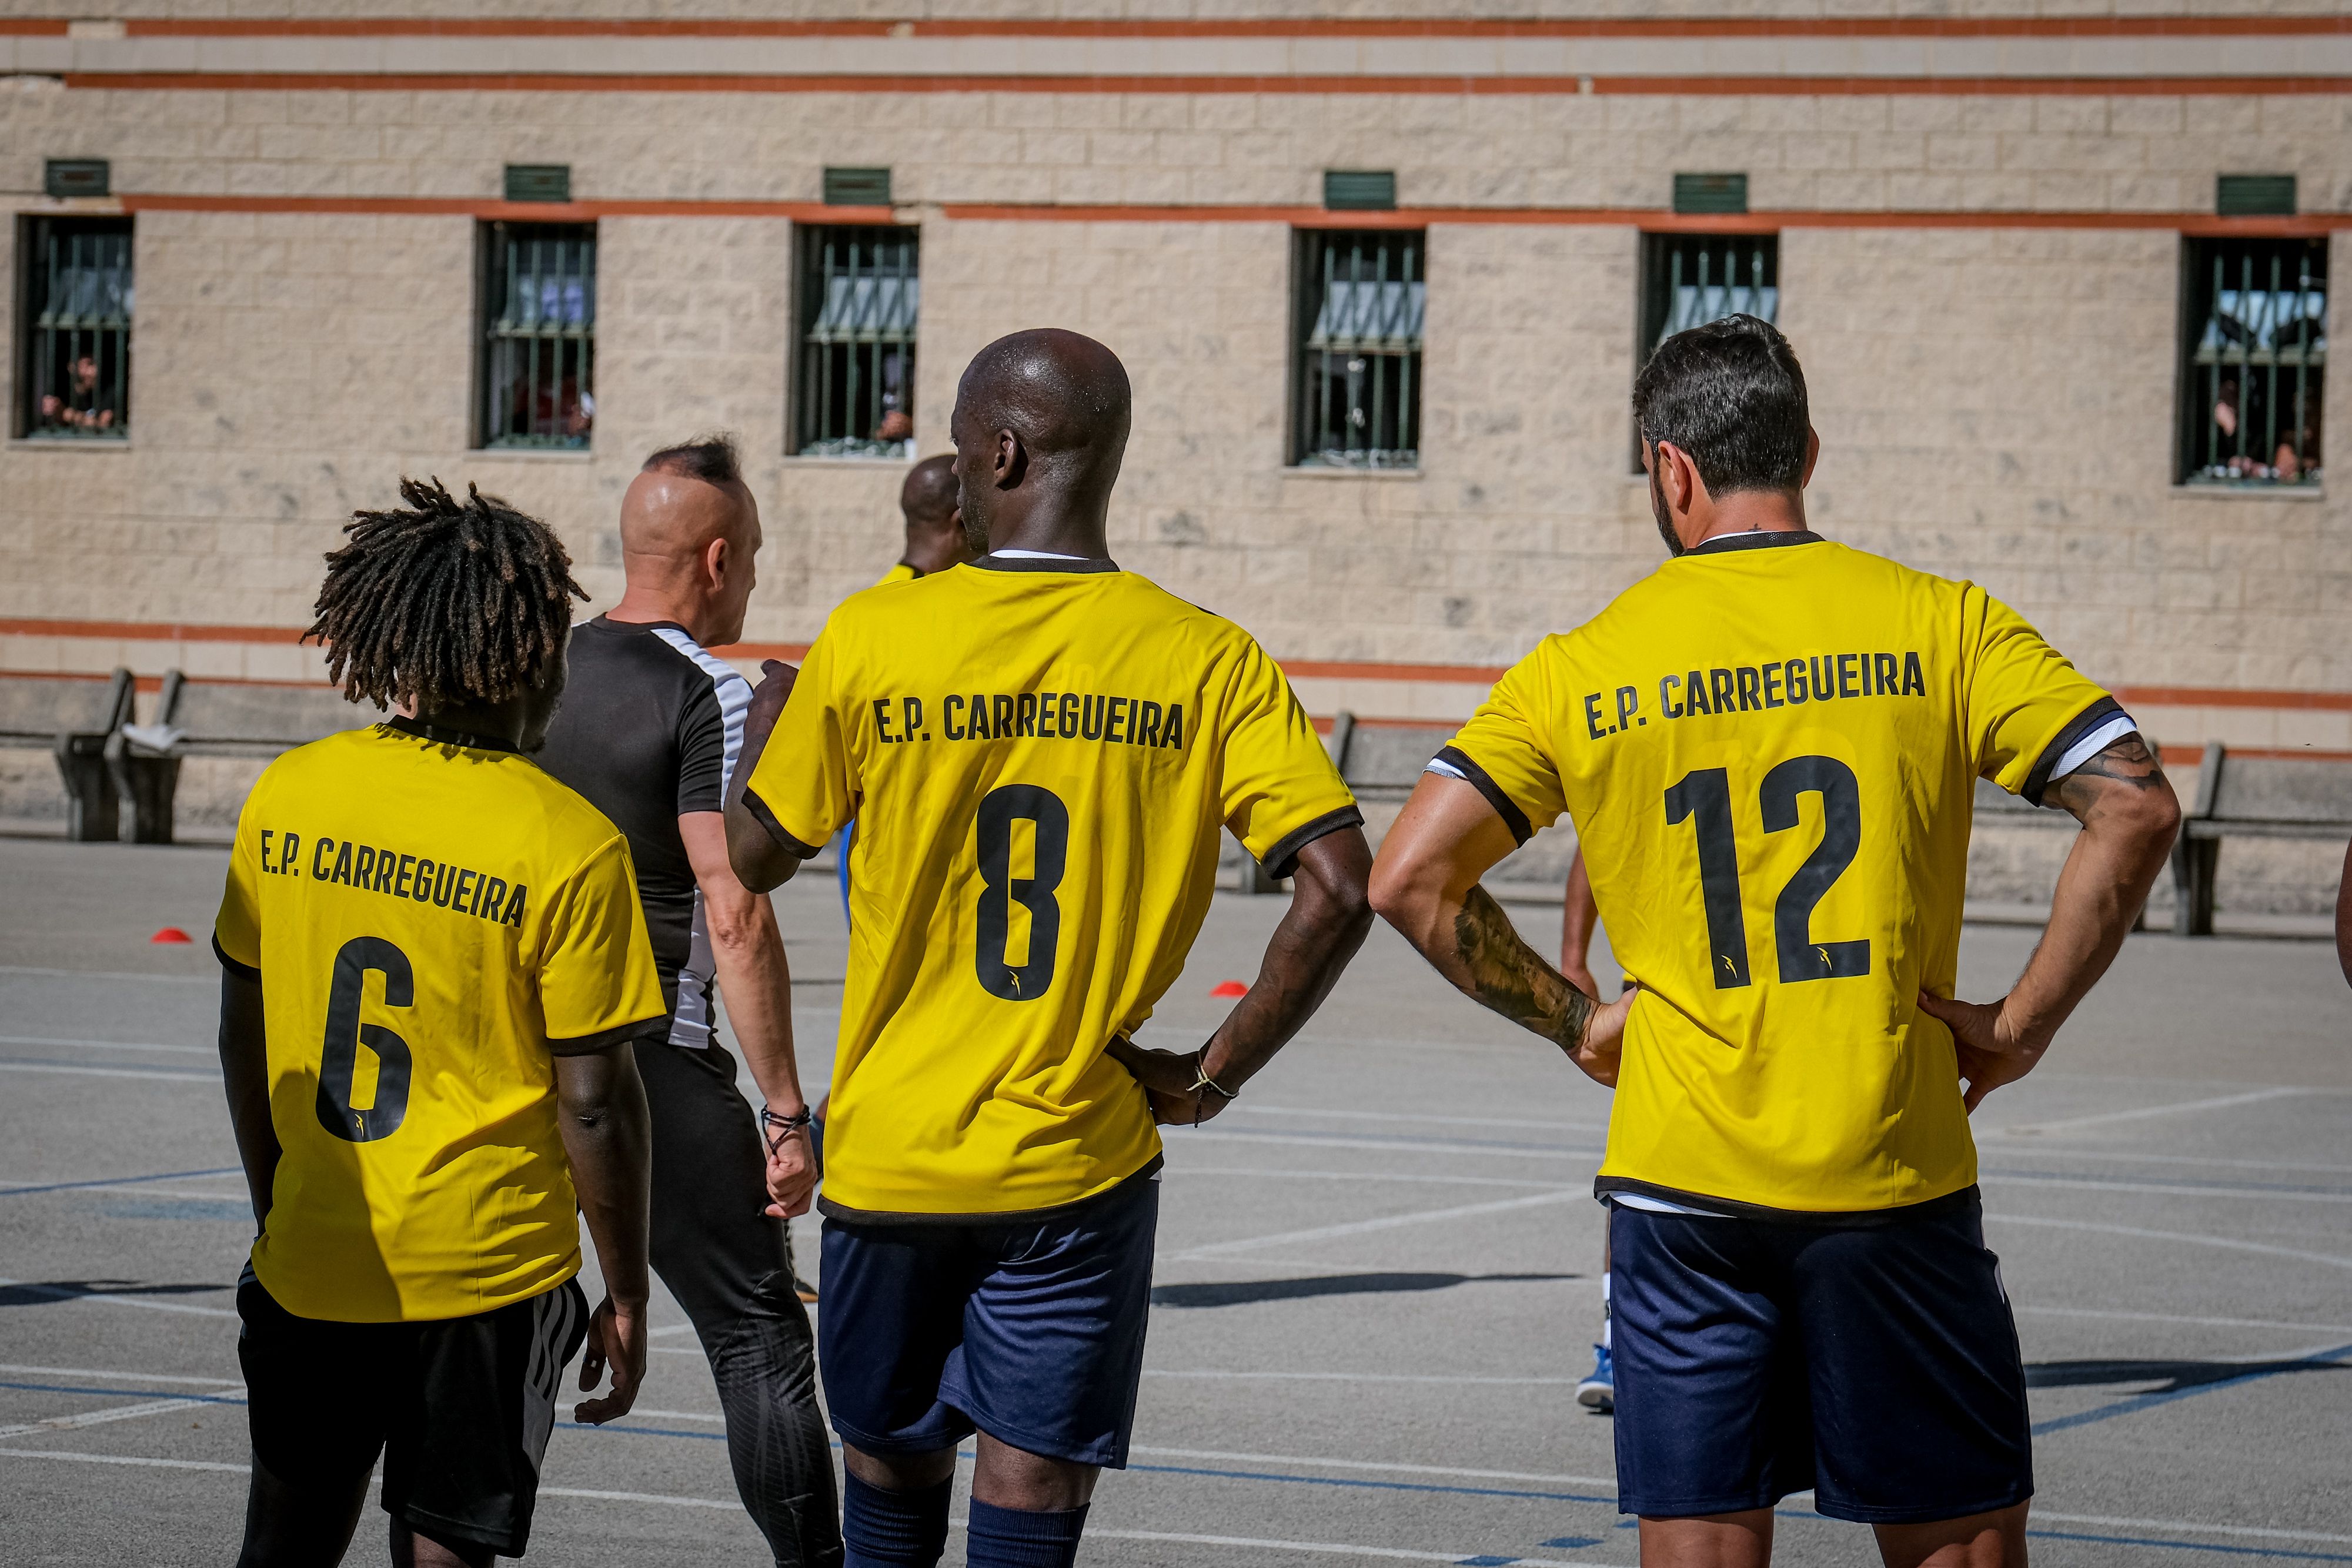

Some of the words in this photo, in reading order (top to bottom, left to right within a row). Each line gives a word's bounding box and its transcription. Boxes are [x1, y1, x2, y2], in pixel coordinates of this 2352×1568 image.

[873, 697, 931, 743] E.P.
[943, 692, 1183, 750] CARREGUEIRA
[1584, 686, 1647, 741] E.P.
[1659, 651, 1926, 720] CARREGUEIRA
[261, 830, 299, 877] E.P.
[312, 837, 527, 928] CARREGUEIRA
[975, 783, 1070, 1001] 8
[1664, 755, 1871, 990] 12
[315, 936, 414, 1143] 6
